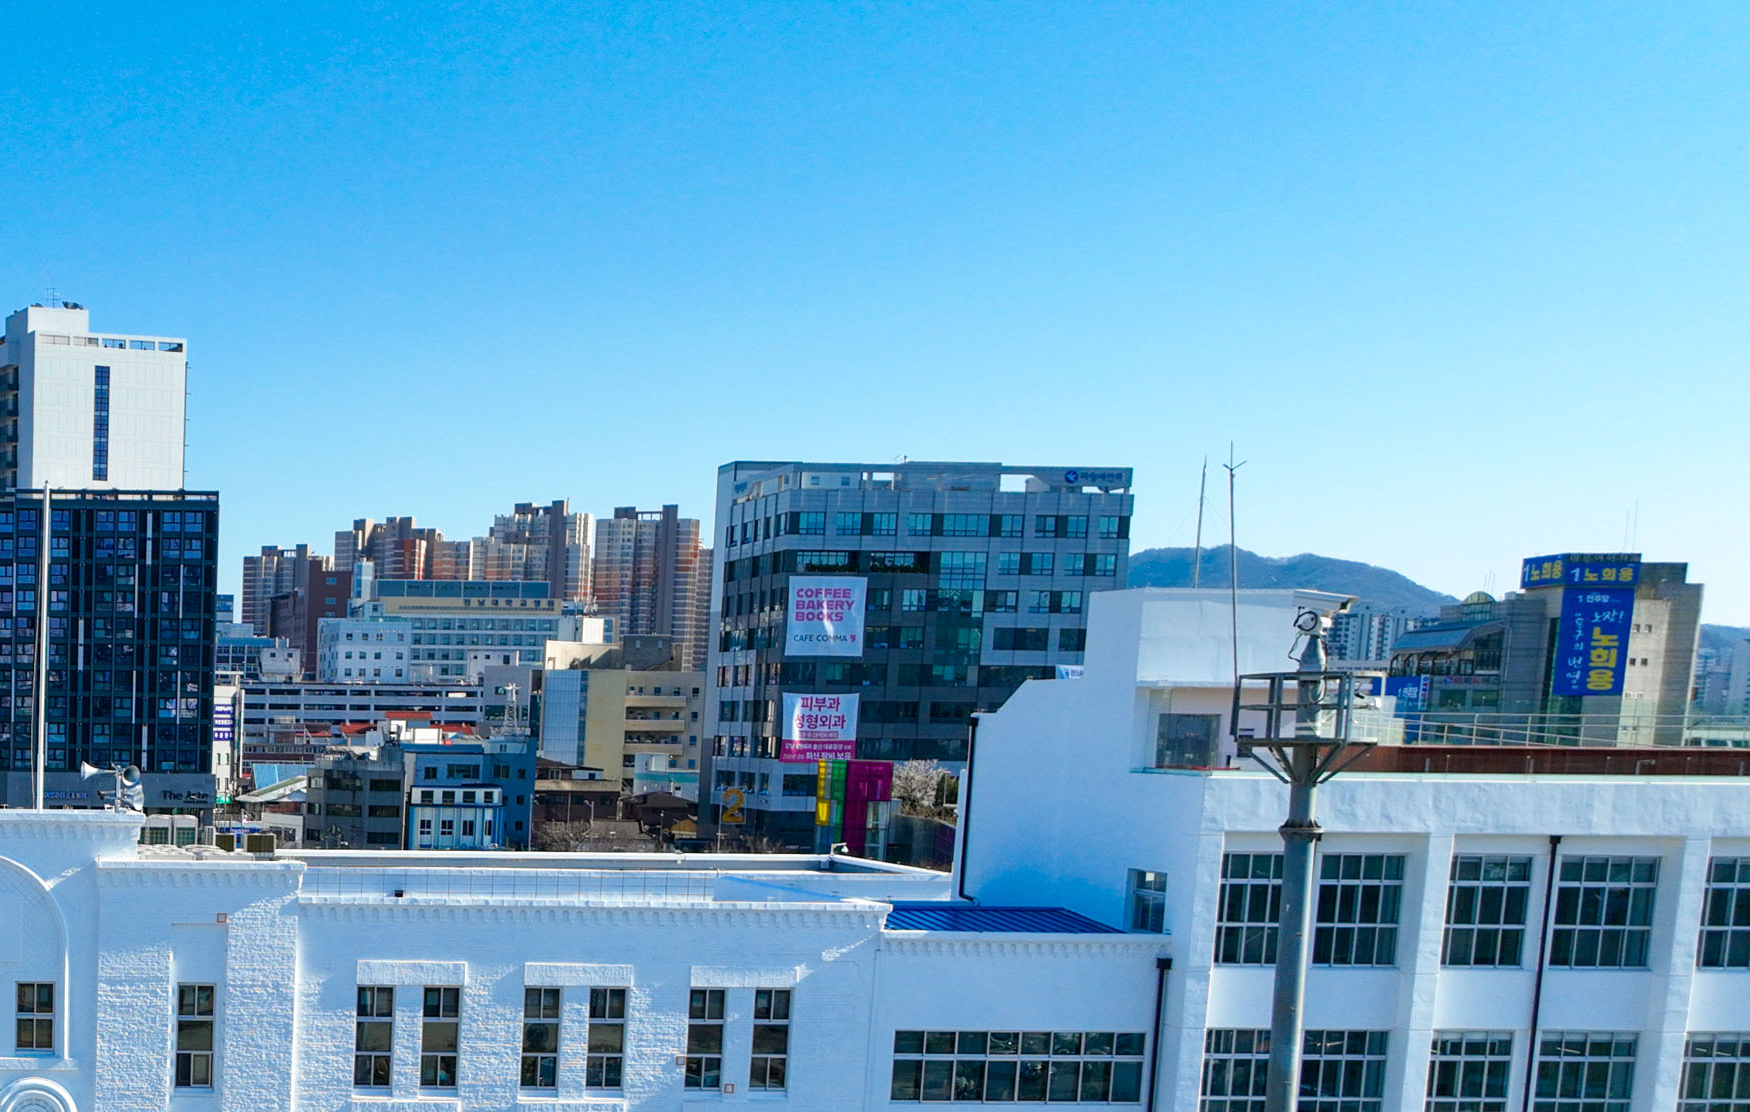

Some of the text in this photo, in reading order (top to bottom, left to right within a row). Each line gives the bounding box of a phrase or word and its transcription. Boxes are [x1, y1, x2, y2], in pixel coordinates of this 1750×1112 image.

[1530, 560, 1563, 581] 노희용
[1570, 567, 1634, 582] 1 노희용
[796, 588, 852, 599] COFFEE
[795, 600, 856, 610] BAKERY
[795, 611, 845, 622] BOOKS
[793, 634, 814, 642] CAFE
[1586, 626, 1619, 691] 노희용
[801, 696, 841, 712] 피부과
[795, 714, 847, 730] 성형외과
[161, 790, 184, 800] The
[722, 788, 745, 822] 2
